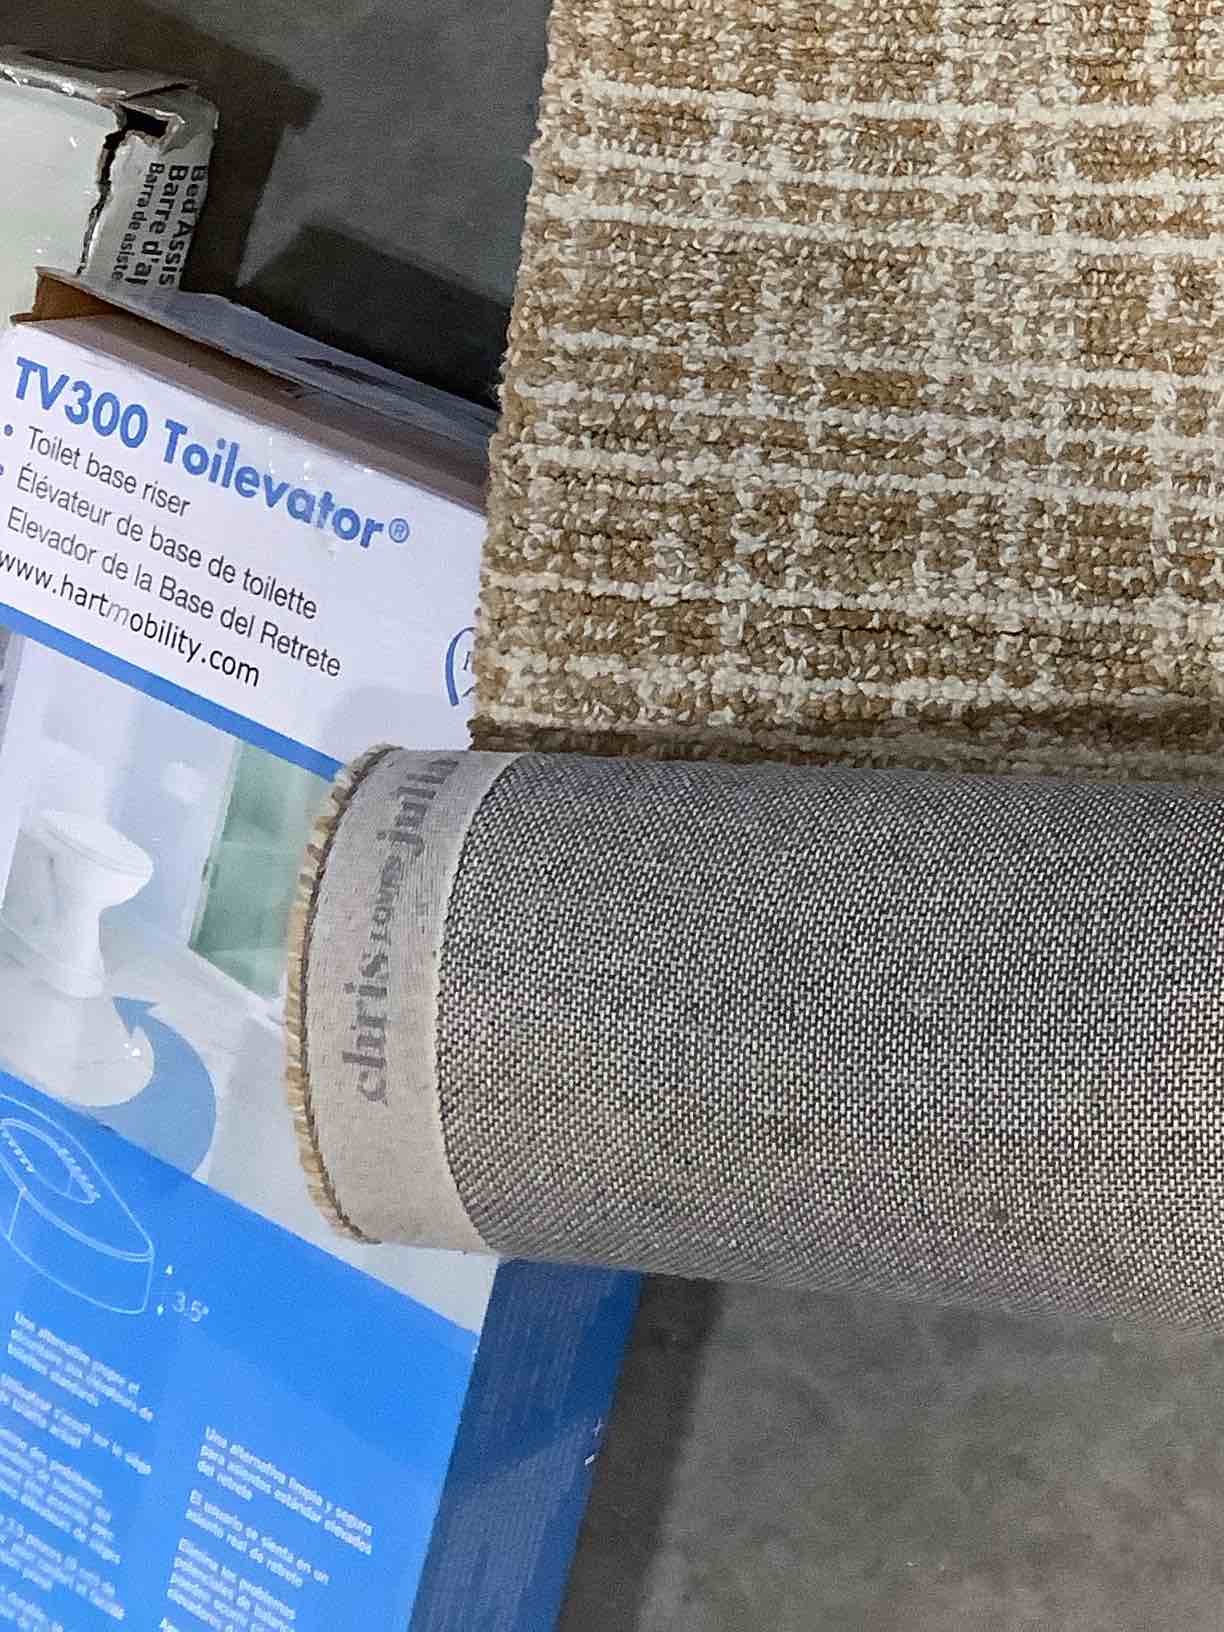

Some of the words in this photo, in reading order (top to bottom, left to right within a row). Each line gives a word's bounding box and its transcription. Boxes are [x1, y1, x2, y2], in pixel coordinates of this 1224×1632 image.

[128, 211, 147, 230] de
[137, 163, 165, 207] Barra
[149, 165, 189, 234] Barre
[16, 356, 148, 448] TV300
[28, 425, 81, 469] Toilet
[85, 452, 137, 494] base
[142, 480, 191, 517] riser
[16, 462, 112, 527] Élévateur
[116, 514, 144, 542] de
[150, 524, 201, 568] base
[208, 555, 236, 583] de
[243, 568, 317, 620] toilette
[0, 550, 261, 687] www.hartmobility.com
[7, 506, 97, 564] Elevador
[101, 553, 129, 581] de
[134, 564, 153, 593] la
[159, 575, 215, 619] Base
[220, 606, 256, 639] del
[261, 620, 341, 678] Retrete
